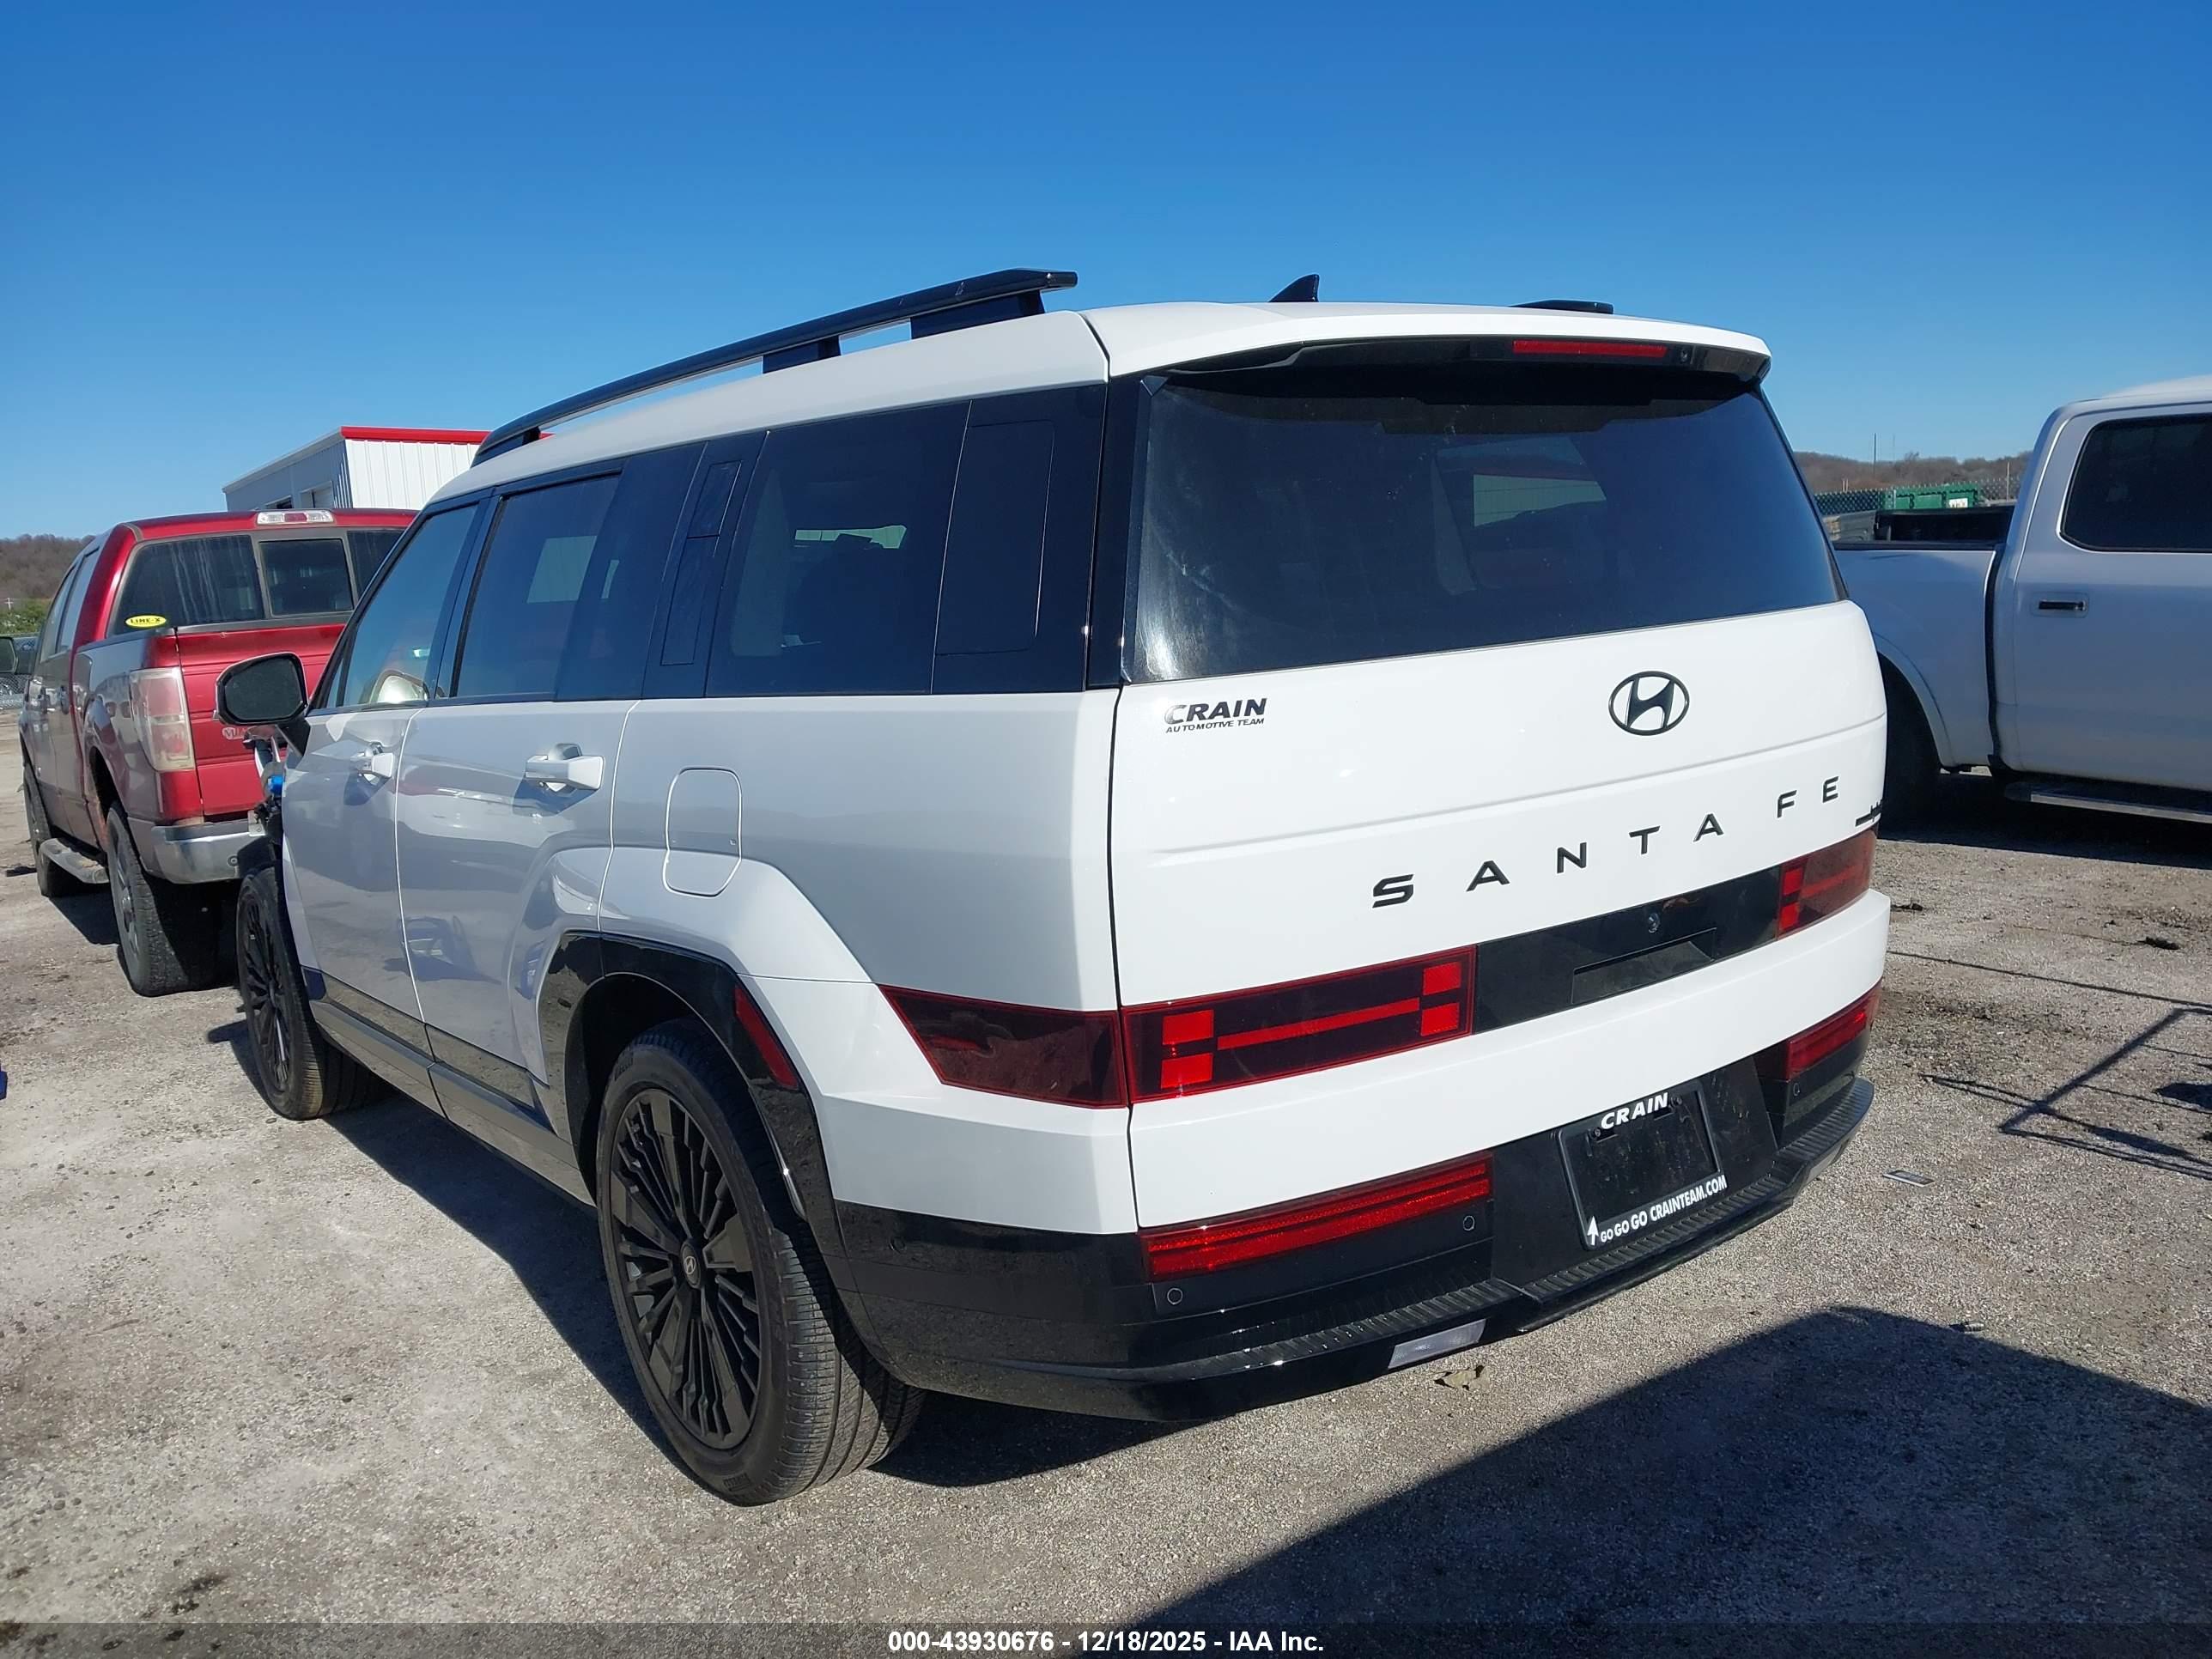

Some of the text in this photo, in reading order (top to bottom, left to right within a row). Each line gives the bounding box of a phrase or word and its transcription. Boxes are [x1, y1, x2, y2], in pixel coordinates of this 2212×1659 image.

[1164, 698, 1267, 725] CRAIN
[1165, 718, 1265, 733] AUTOMOTIVE TEAM
[1372, 813, 1724, 908] SANTA
[1777, 776, 1839, 817] FE
[1601, 1092, 1668, 1129] CRAIN
[1600, 1175, 1728, 1243] GO GO GO CRAINTEAM.COM
